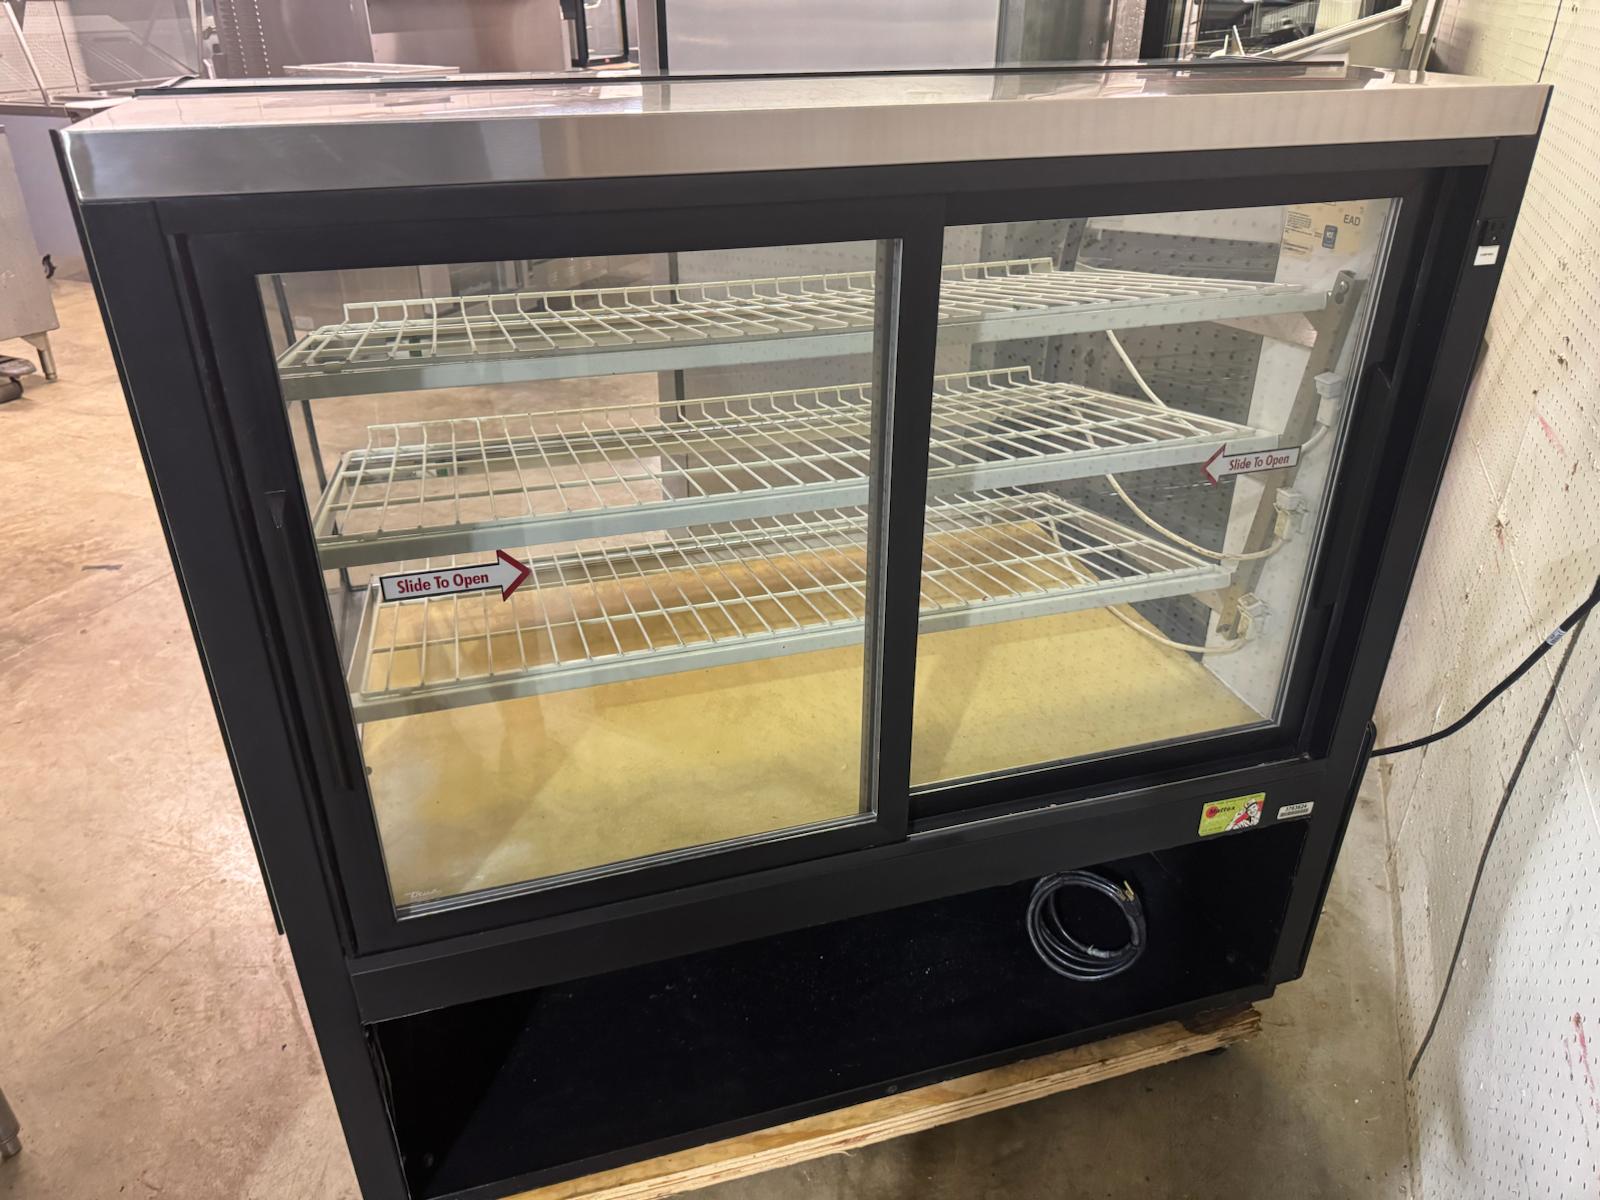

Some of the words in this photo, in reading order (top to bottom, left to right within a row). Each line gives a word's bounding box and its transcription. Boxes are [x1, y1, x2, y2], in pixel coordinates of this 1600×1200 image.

[1229, 458, 1251, 471] Slide
[1254, 456, 1264, 467] To
[1265, 454, 1290, 467] Open
[396, 577, 431, 594] Slide
[433, 575, 450, 589] To
[452, 573, 489, 589] Open
